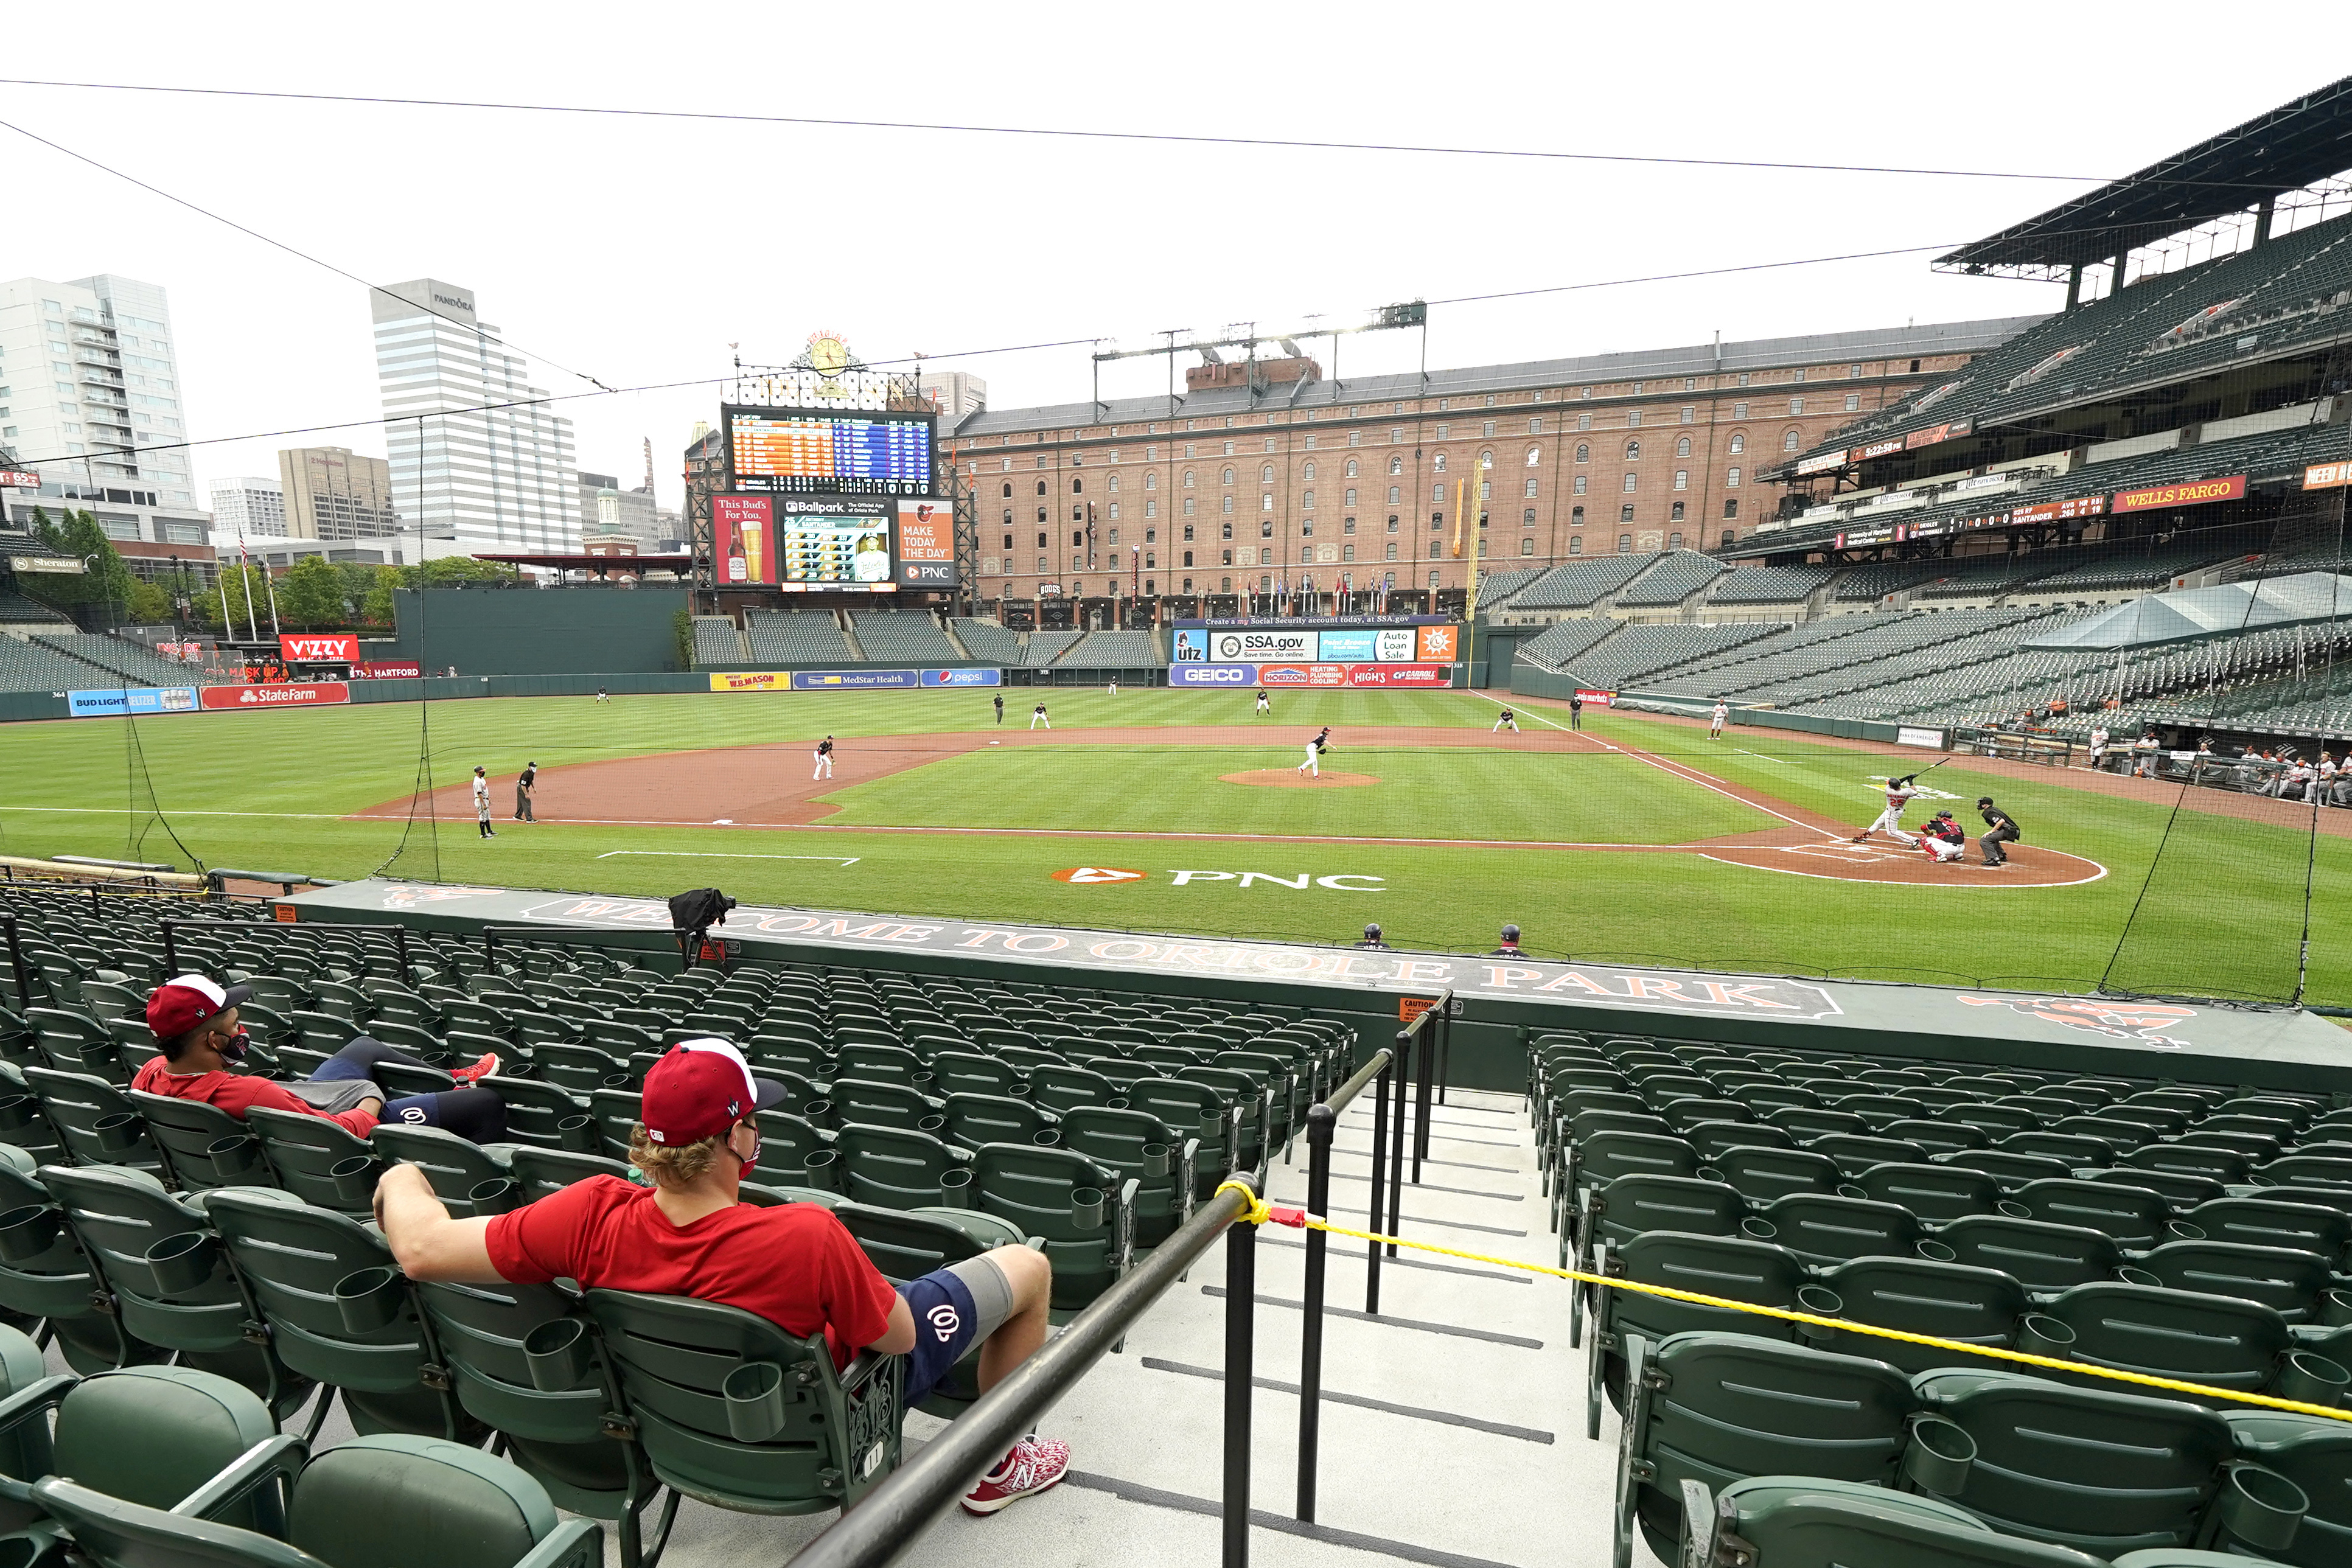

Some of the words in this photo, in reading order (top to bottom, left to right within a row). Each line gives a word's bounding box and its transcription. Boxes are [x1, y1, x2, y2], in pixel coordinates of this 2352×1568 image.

[434, 294, 473, 312] PANDORA
[13, 472, 29, 483] 65
[2306, 466, 2337, 484] NEED
[888, 484, 897, 493] 0
[904, 484, 913, 494] 0
[920, 484, 929, 494] 0
[2126, 490, 2174, 507] WELLS
[2177, 483, 2231, 500] FARGO
[718, 500, 741, 508] This
[742, 500, 767, 509] Bud's
[2091, 497, 2103, 506] RBI
[798, 501, 845, 514] Ballpark
[741, 510, 762, 519] You.
[2012, 512, 2053, 524] SANTANDER
[2092, 505, 2101, 514] 19
[1975, 517, 1981, 528] 0
[1988, 515, 1995, 526] 0
[2002, 514, 2009, 524] 0
[904, 526, 933, 535] MAKE
[904, 537, 936, 546] TODAY
[904, 548, 924, 557] THE
[927, 549, 946, 558] DAY
[34, 558, 79, 568] Sheraton
[921, 567, 949, 578] PNC
[1275, 617, 1307, 625] Security
[288, 640, 347, 656] VIZZY
[1245, 636, 1303, 650] SSA.gov
[1384, 641, 1406, 650] Loan
[1385, 651, 1405, 660] Sale
[375, 669, 419, 677] HARTFORD
[954, 672, 983, 683] pepsi
[1185, 669, 1243, 681] GEICO
[1355, 672, 1386, 683] HIGH'S
[843, 675, 876, 684] MedStar
[877, 675, 903, 683] Health
[1588, 693, 1608, 703] markets
[1167, 869, 1389, 892] PNC
[562, 900, 944, 943] WECOME
[954, 927, 1070, 953] TO
[1089, 939, 1455, 984] ORIOLE
[1479, 964, 1802, 1011] PARK
[195, 1008, 206, 1019] W
[727, 1101, 739, 1117] W
[868, 1448, 879, 1471] 11
[1011, 1463, 1037, 1489] N
